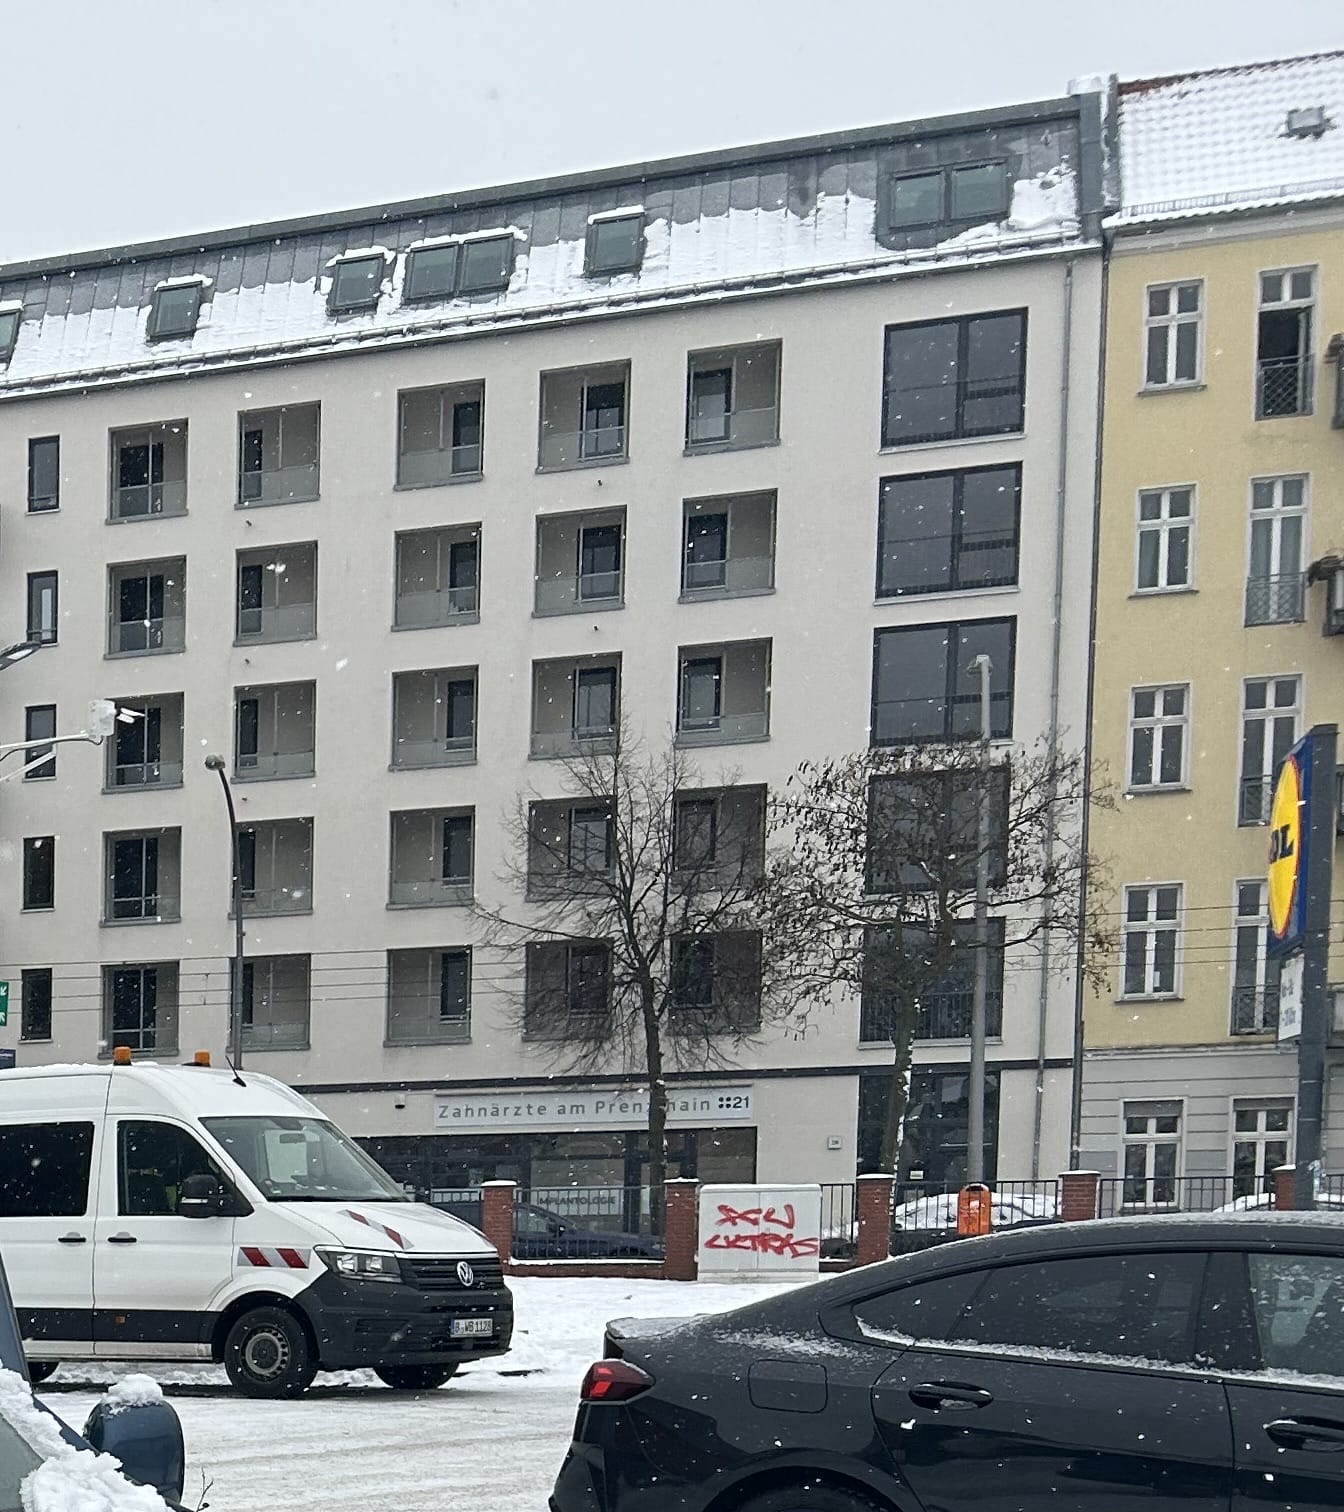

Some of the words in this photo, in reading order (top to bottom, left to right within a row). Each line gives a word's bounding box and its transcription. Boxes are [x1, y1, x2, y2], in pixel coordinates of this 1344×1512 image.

[438, 1103, 548, 1118] Zahnärzte
[557, 1103, 585, 1115] am
[732, 1096, 749, 1108] 21
